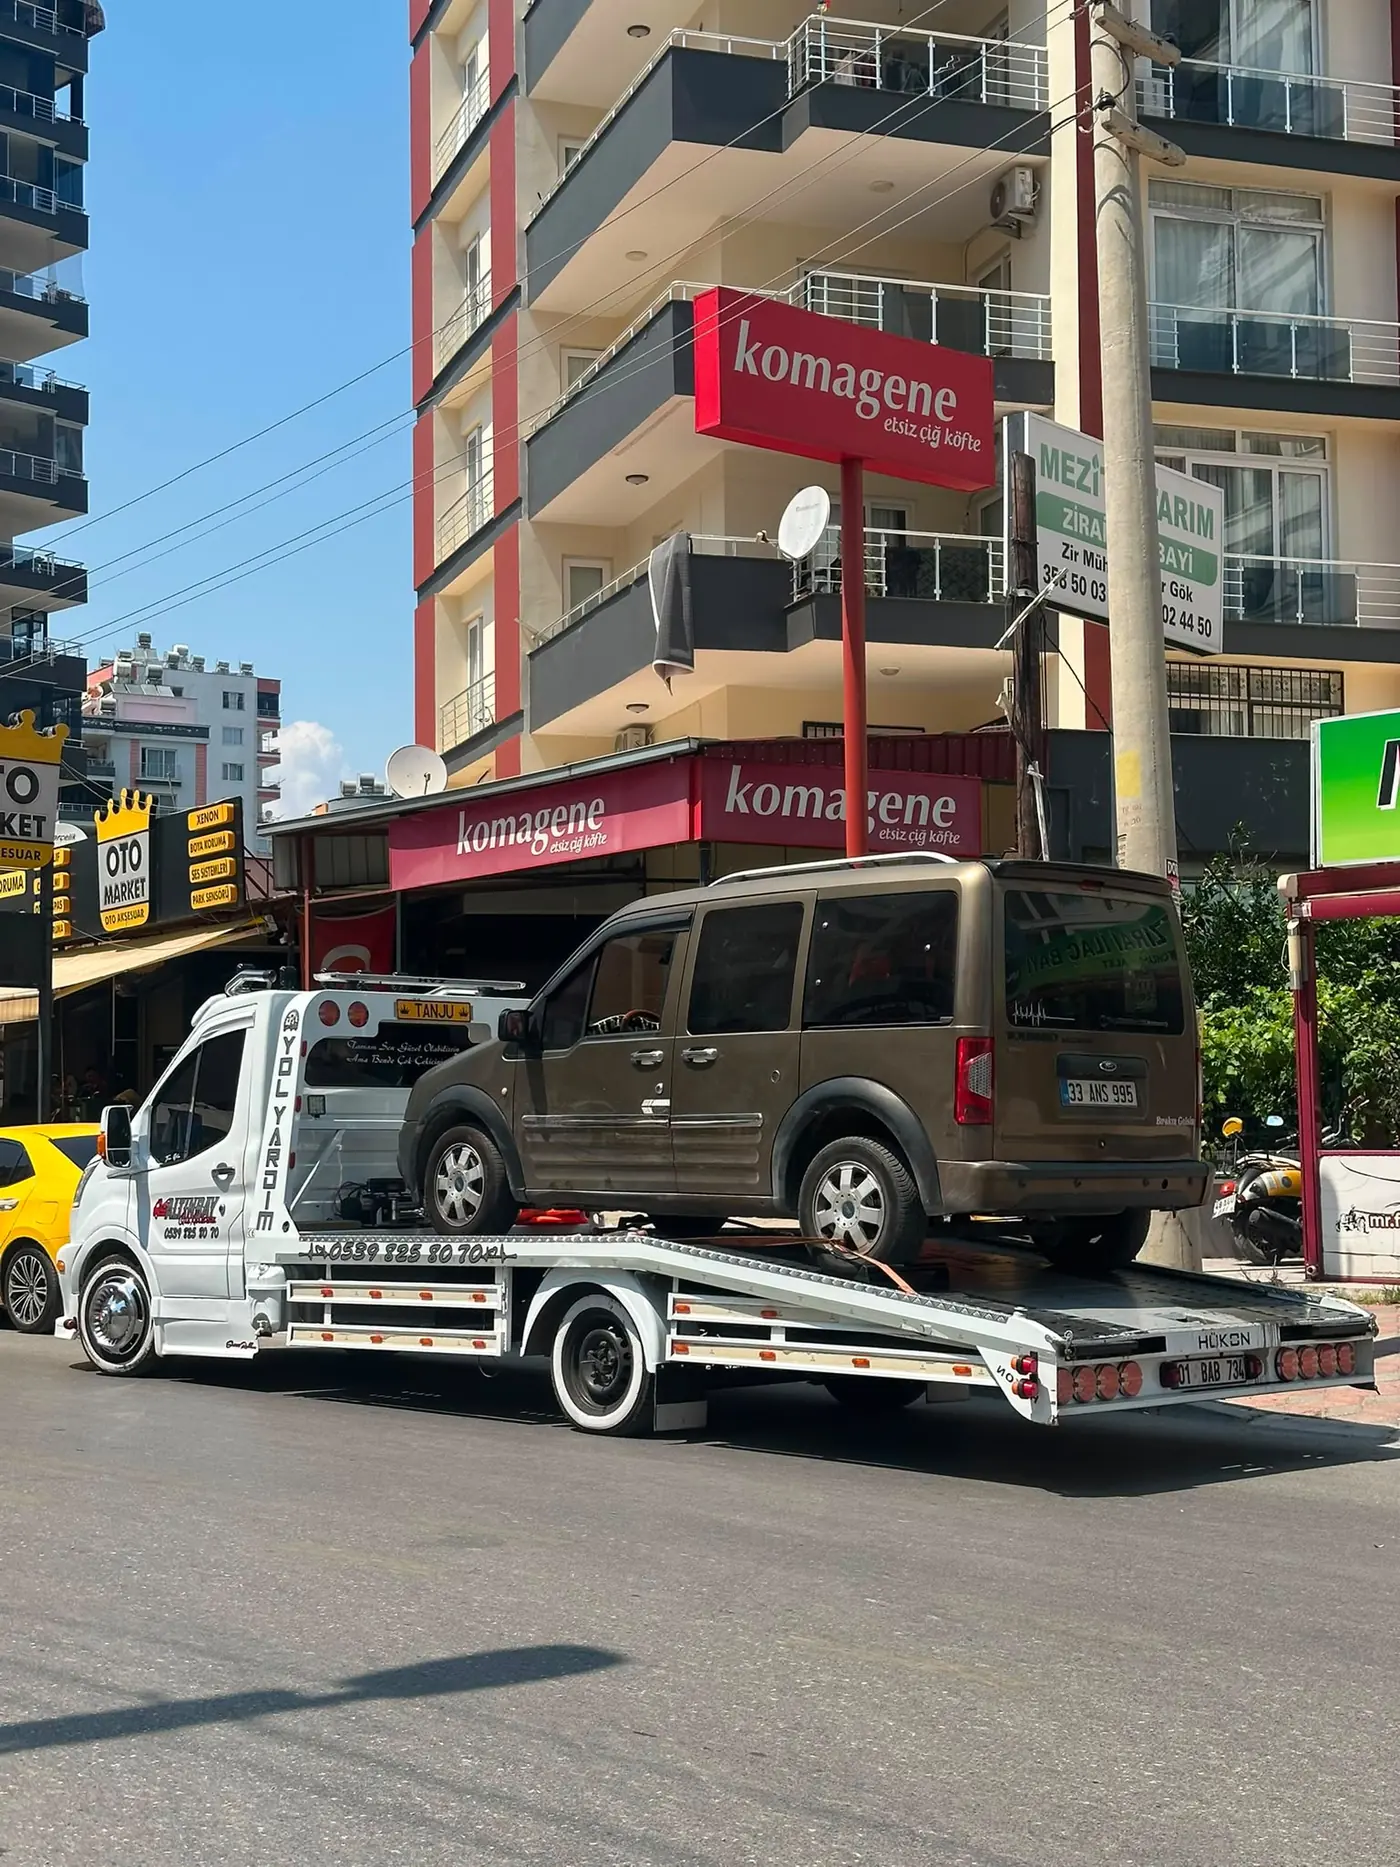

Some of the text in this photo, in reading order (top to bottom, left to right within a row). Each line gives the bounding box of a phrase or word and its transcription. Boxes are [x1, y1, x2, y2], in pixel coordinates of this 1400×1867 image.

[734, 319, 957, 422] komagene
[883, 416, 981, 452] etsiz çiğ köfte
[1040, 442, 1214, 540] MEZİ ARIM
[1062, 541, 1079, 562] Zir
[1170, 580, 1193, 603] Gök
[1071, 572, 1087, 596] 50
[1091, 580, 1106, 603] 03
[1162, 604, 1176, 626] 02
[1180, 611, 1194, 632] 44
[1198, 616, 1212, 638] 50
[196, 809, 219, 825] XENON
[456, 798, 605, 856] komagene
[550, 832, 608, 854] etsiz çiğ köfte
[879, 828, 960, 847] etsiz çiğ köfte
[106, 838, 142, 878] OTO
[104, 878, 146, 905] MARKET
[105, 908, 145, 925] OTO AKSESUAR
[414, 1003, 454, 1019] TANJU
[275, 1036, 296, 1098] YOL
[1068, 1083, 1133, 1103] 33 ANS 995
[256, 1106, 287, 1232] YARDIM
[329, 1241, 483, 1264] 0539 825 80 70
[1198, 1331, 1250, 1349] HÜKON
[1178, 1359, 1244, 1385] 01 BAB 734
